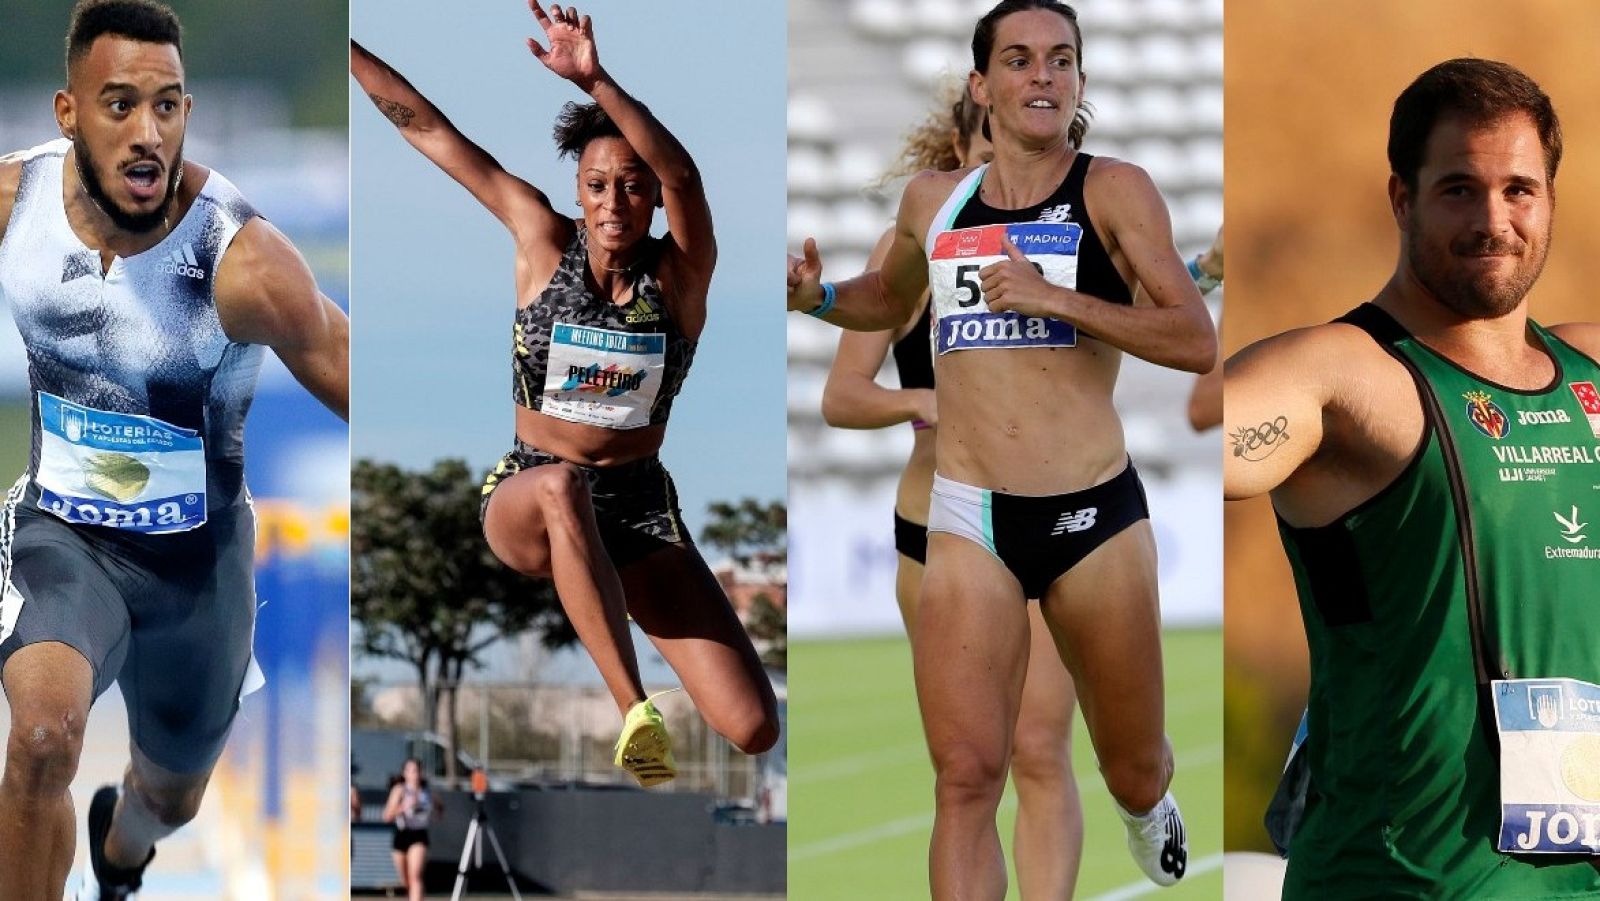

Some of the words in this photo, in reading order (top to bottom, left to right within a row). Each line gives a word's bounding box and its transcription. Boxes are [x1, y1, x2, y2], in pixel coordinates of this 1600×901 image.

[1024, 234, 1072, 244] MADRID
[155, 262, 204, 279] adidas
[625, 313, 660, 324] adidas
[571, 328, 604, 347] MEETING
[605, 333, 627, 351] IBIZA
[568, 364, 642, 391] PELETEIRO
[1492, 445, 1594, 463] VILLARREAL
